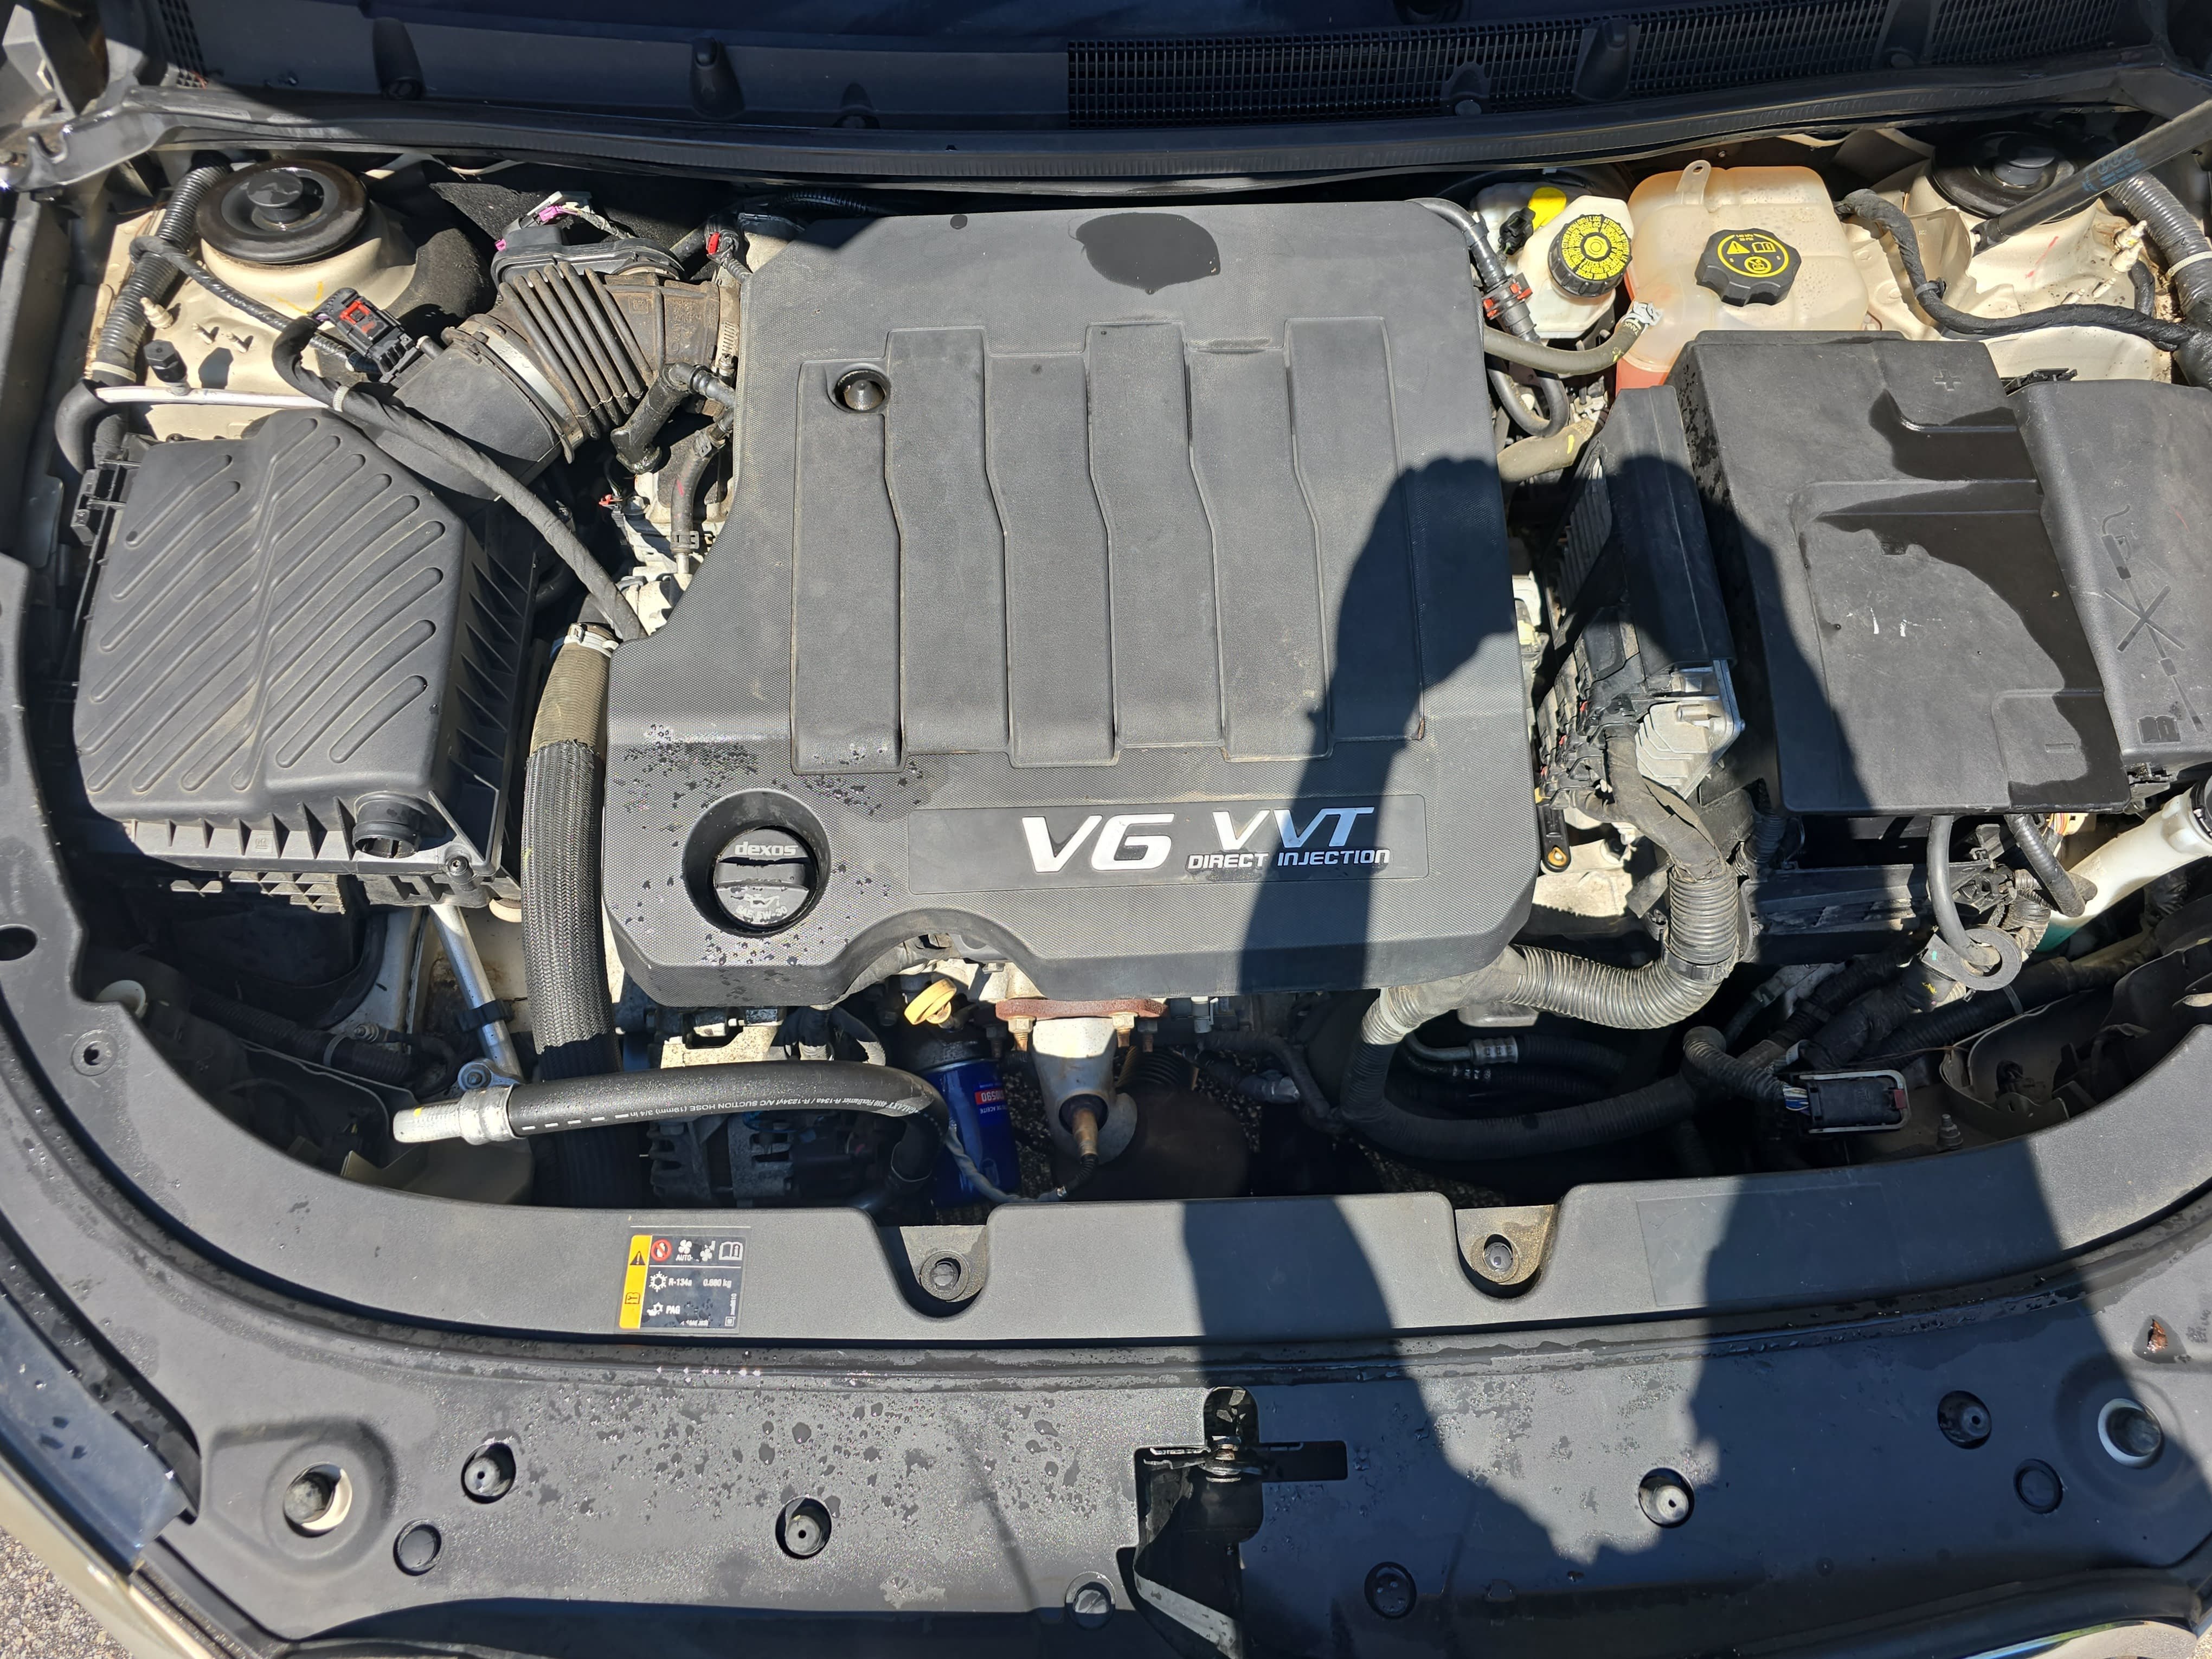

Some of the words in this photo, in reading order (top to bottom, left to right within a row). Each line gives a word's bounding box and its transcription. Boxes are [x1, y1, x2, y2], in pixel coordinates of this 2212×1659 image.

[1623, 322, 1639, 336] TANK
[1021, 813, 1175, 873] V6
[1212, 807, 1374, 851] VVT
[735, 841, 798, 856] dexos
[1189, 852, 1269, 870] DIRECT
[1277, 849, 1391, 867] INJECTION
[736, 905, 754, 918] SAE
[756, 905, 788, 919] 5W-30
[690, 1103, 716, 1112] HOSE
[718, 1100, 758, 1109] SUCTION
[842, 1098, 876, 1106] FlexBarrier
[655, 1105, 687, 1115] (19mm)
[668, 1278, 692, 1287] R-134a
[722, 1278, 732, 1289] kg
[666, 1305, 680, 1315] PAG
